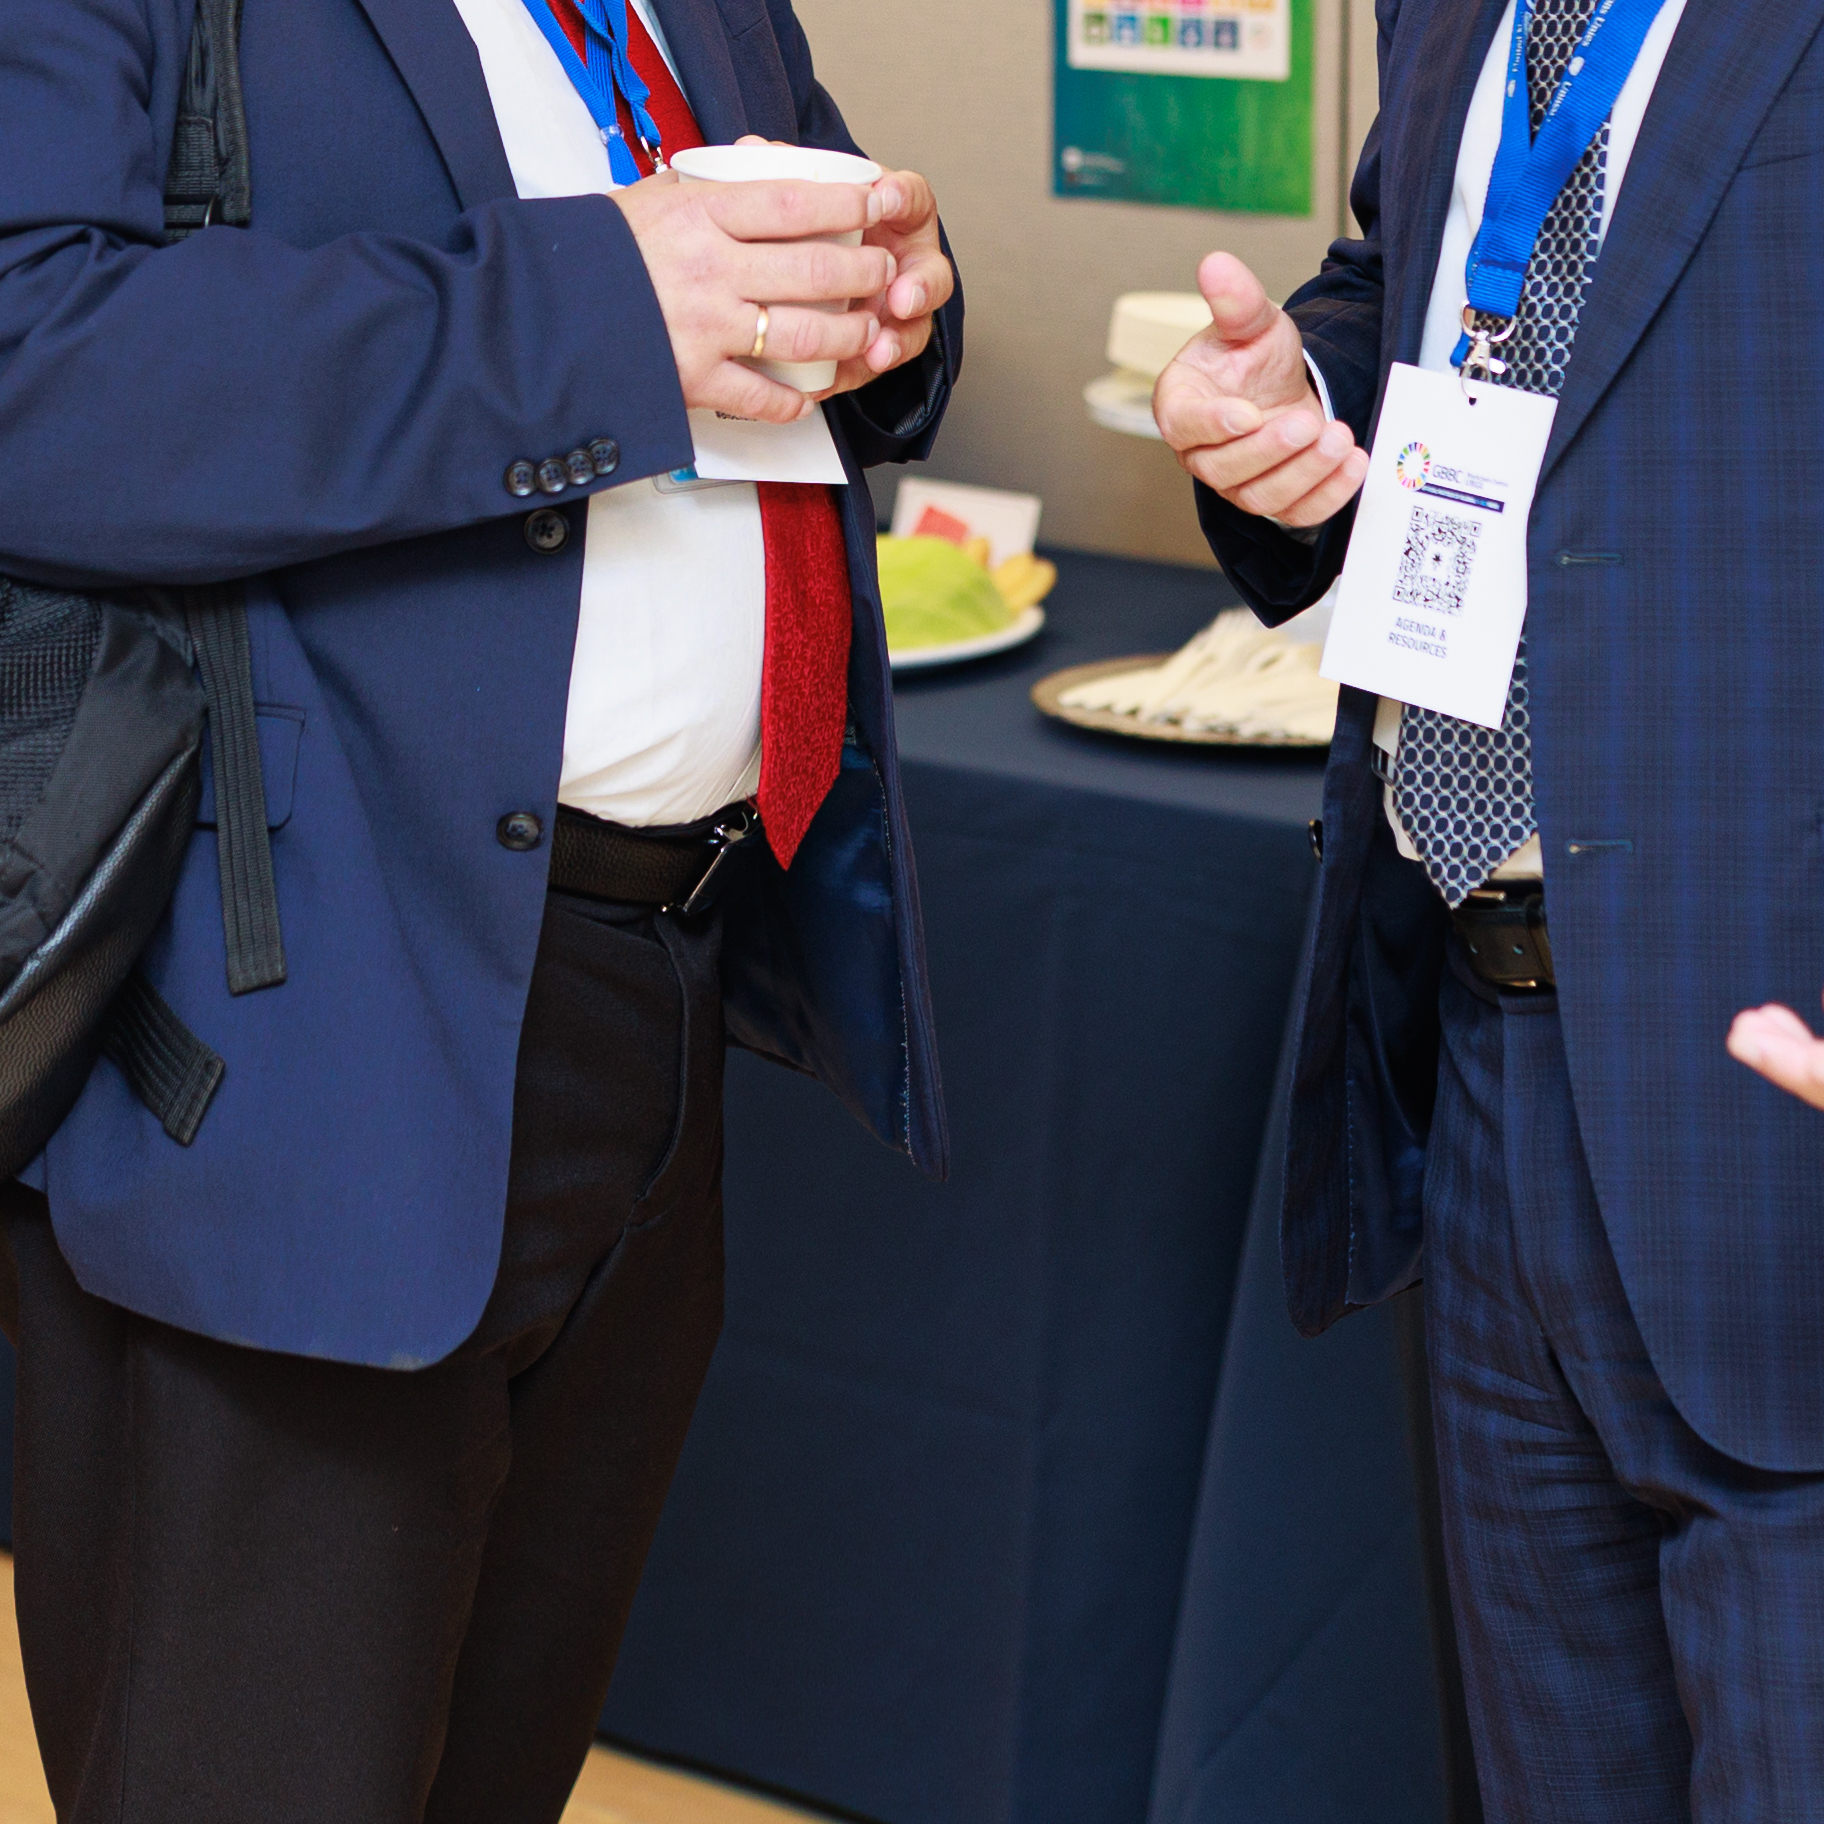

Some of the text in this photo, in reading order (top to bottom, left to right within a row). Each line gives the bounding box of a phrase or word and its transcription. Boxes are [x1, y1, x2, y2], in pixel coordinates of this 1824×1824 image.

[1581, 17, 1606, 47] Unies
[1433, 464, 1463, 484] GBBC
[1395, 617, 1447, 641] AGENDA &
[1387, 631, 1448, 659] RESOURCES
